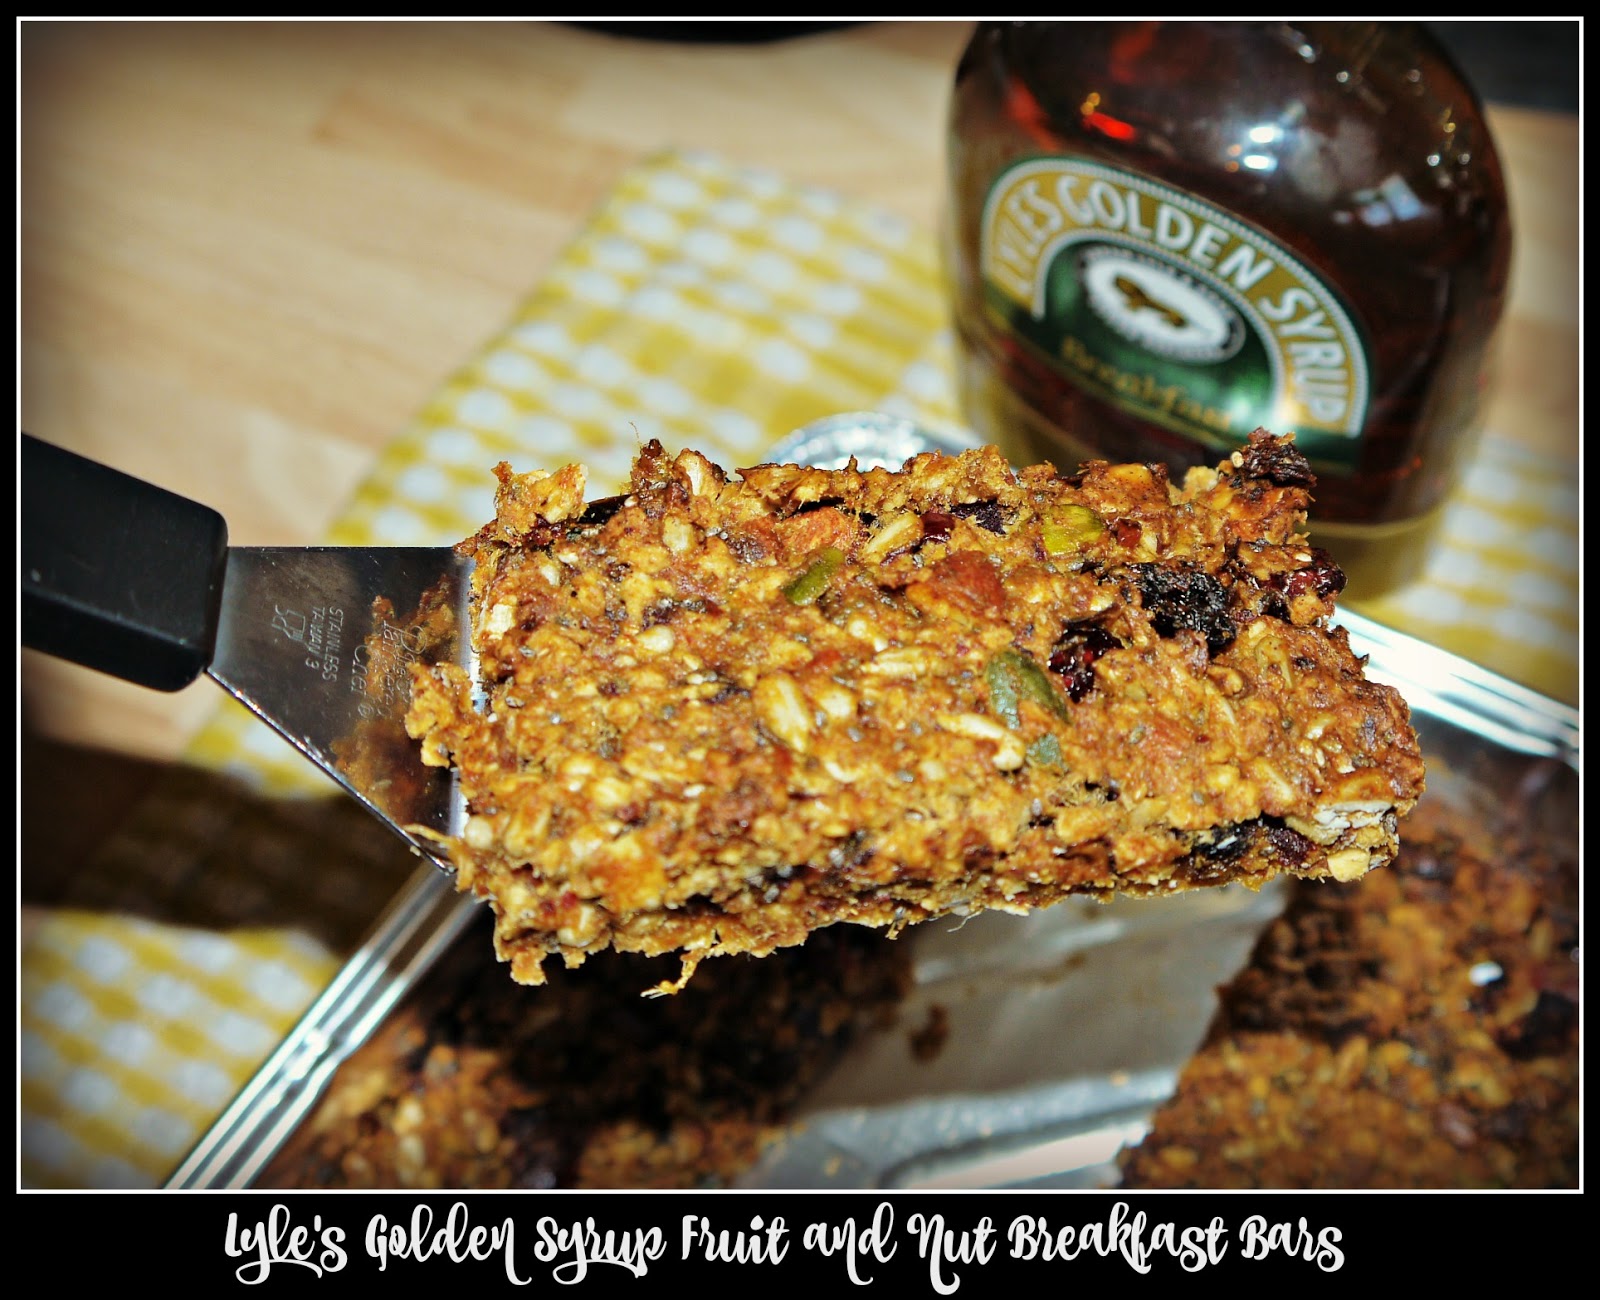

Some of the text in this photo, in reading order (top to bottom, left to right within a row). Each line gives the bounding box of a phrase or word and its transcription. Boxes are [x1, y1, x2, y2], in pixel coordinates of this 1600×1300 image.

[1056, 174, 1277, 292] GOLDEN
[1258, 286, 1348, 423] SYRUP
[309, 606, 326, 660] TAIWAN
[322, 605, 344, 682] STAINLESS
